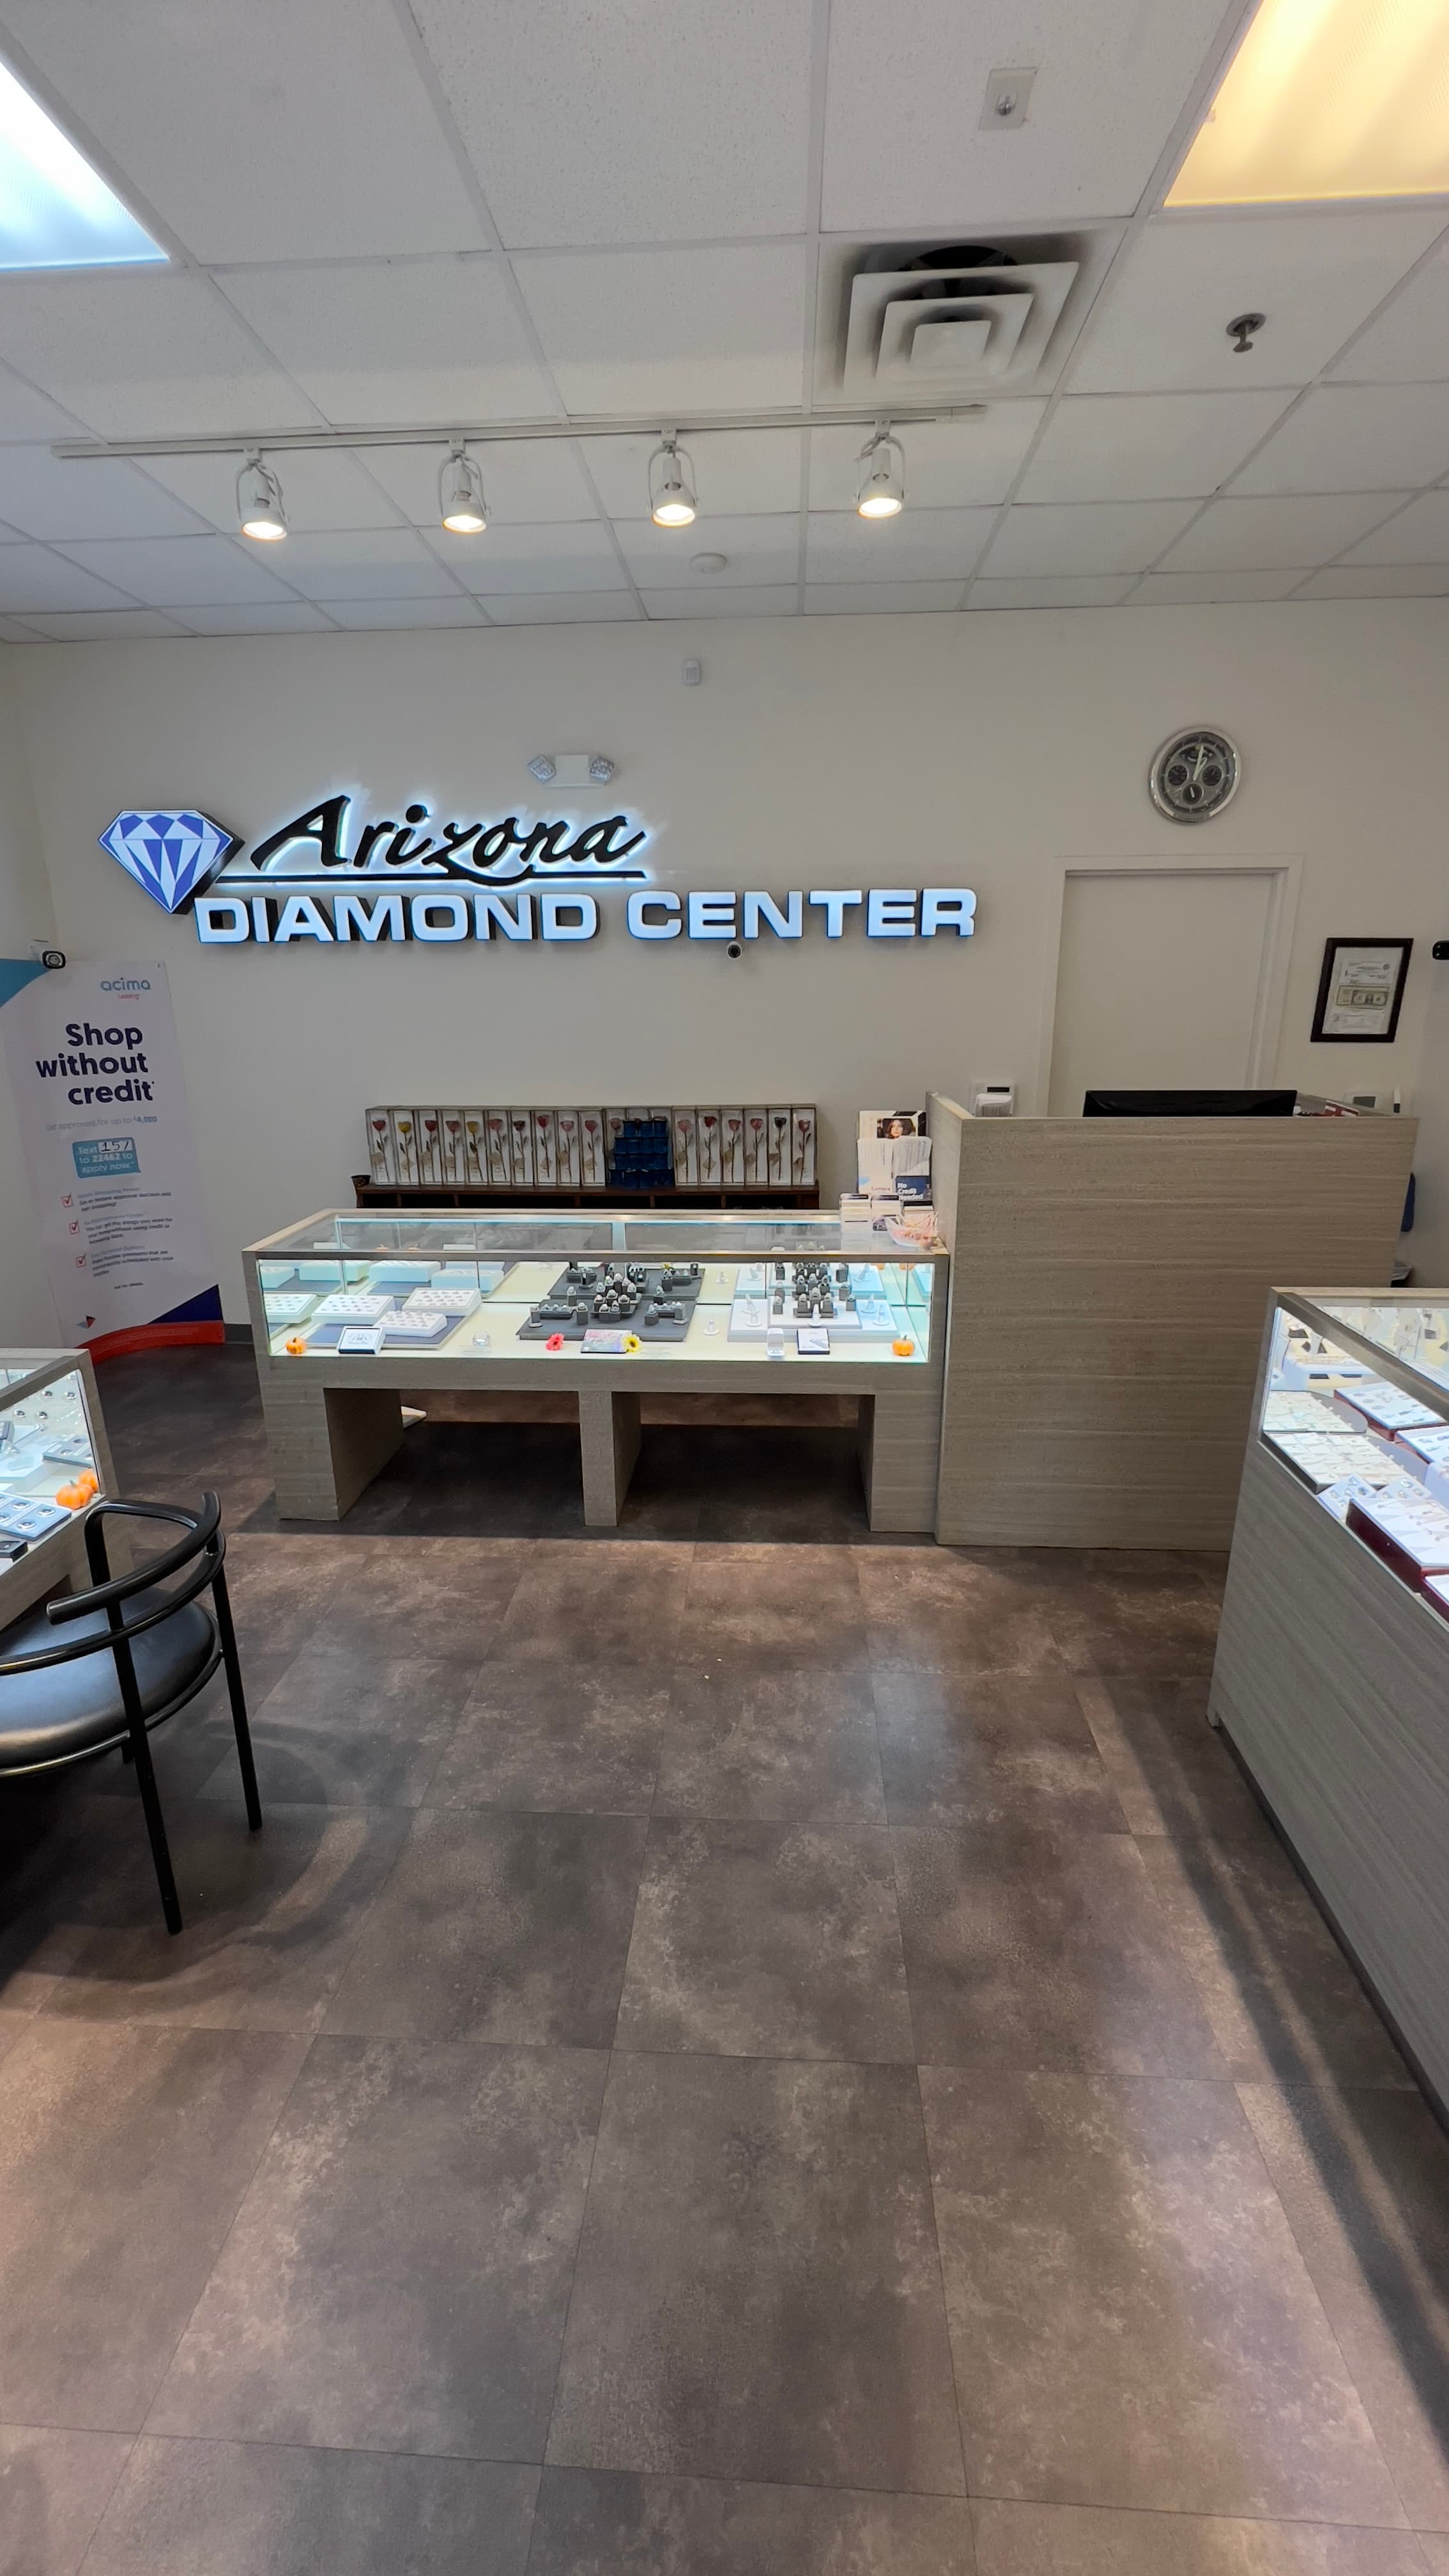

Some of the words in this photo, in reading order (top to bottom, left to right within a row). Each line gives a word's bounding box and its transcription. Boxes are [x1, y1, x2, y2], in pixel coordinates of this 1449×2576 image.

[250, 795, 647, 885] Arizona
[194, 893, 601, 944] DIAMOND
[627, 887, 977, 940] CENTER
[100, 977, 151, 991] acima
[66, 1023, 142, 1050] Shop
[36, 1052, 148, 1078] without
[78, 1146, 98, 1154] Text
[82, 1164, 107, 1174] apply
